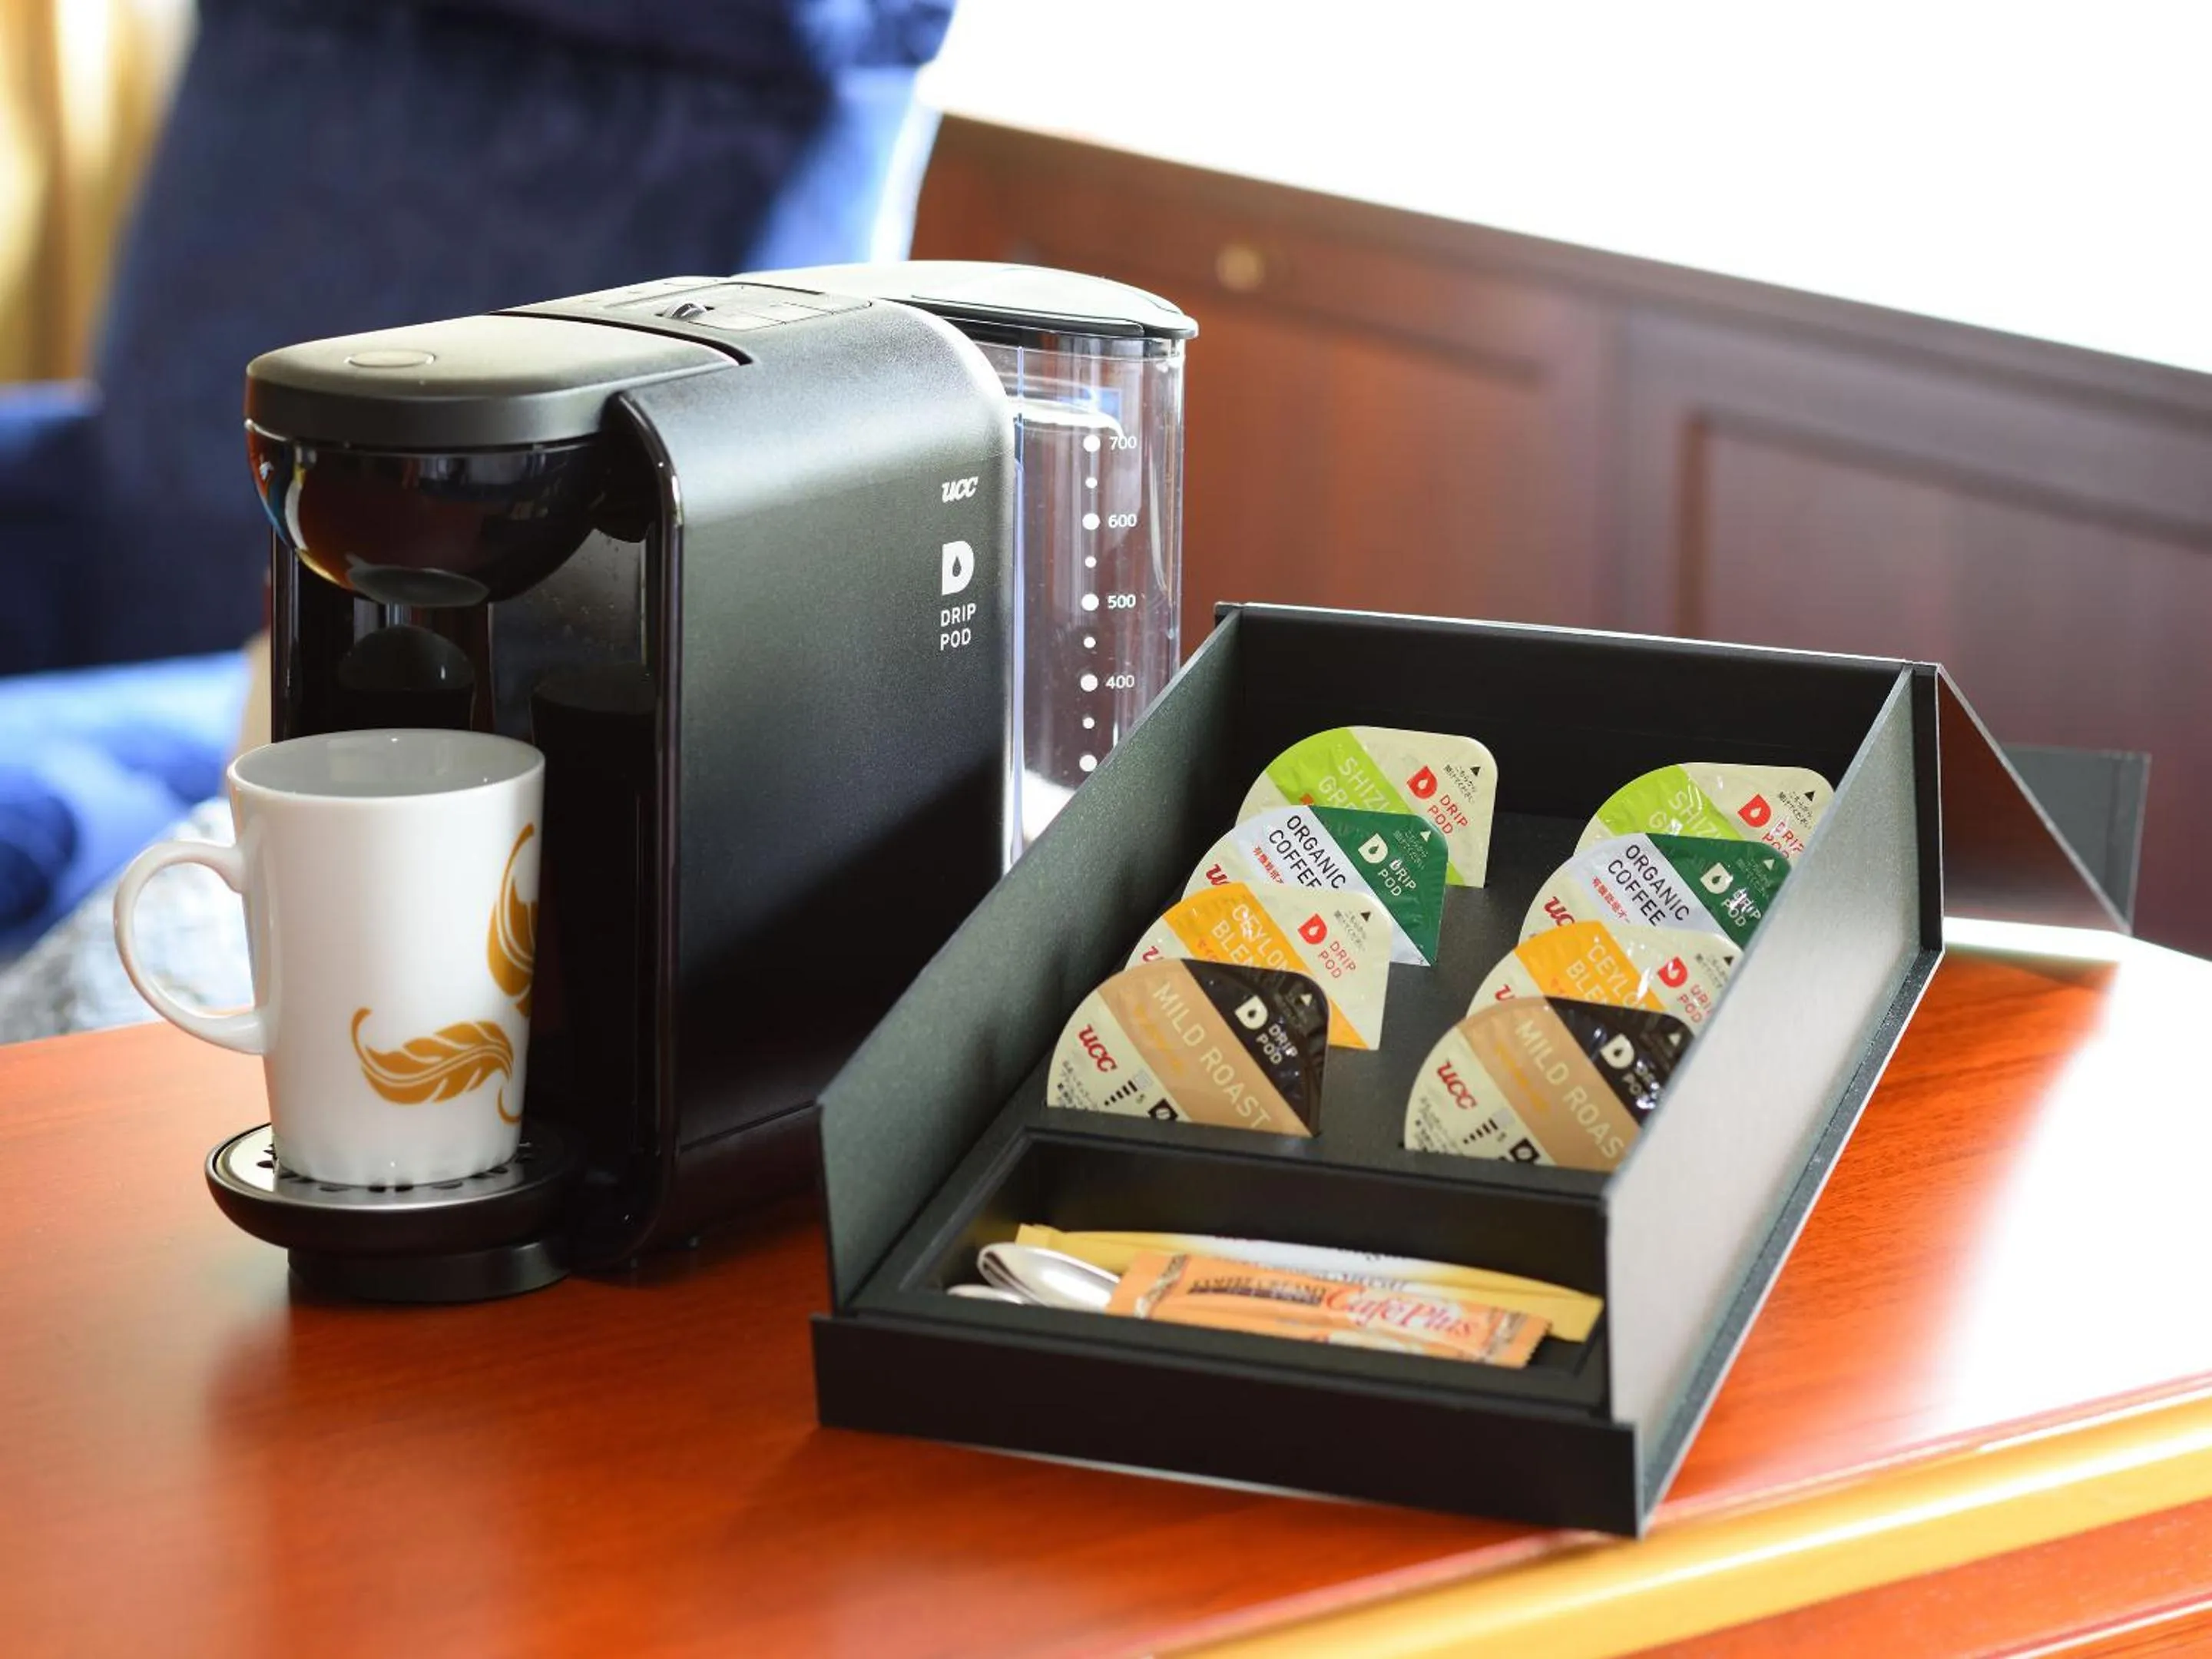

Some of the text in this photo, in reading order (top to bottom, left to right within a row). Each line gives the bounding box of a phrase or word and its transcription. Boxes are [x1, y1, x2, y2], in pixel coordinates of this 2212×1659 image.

[1109, 435, 1137, 450] 700
[1108, 513, 1137, 528] 600
[940, 602, 977, 627] DRIP
[1107, 594, 1136, 609] 500
[940, 628, 972, 651] POD
[1106, 674, 1134, 689] 400
[1428, 805, 1454, 835] POD
[1440, 794, 1469, 828] DRIP
[1286, 815, 1346, 889] ORGANIC
[1378, 869, 1402, 897] POD
[1389, 859, 1418, 891] DRIP
[1626, 843, 1690, 921] ORGANIC
[1608, 859, 1666, 927] COFFEE
[1318, 951, 1343, 979] POD
[1330, 941, 1356, 972] DRIP
[1677, 992, 1704, 1024] POD
[1153, 982, 1206, 1047] MILD
[1200, 1046, 1272, 1129] ROAST
[1256, 1033, 1283, 1065] POD
[1268, 1024, 1298, 1058] DRIP
[1515, 1019, 1568, 1086] MILD
[1564, 1086, 1626, 1160] ROAS
